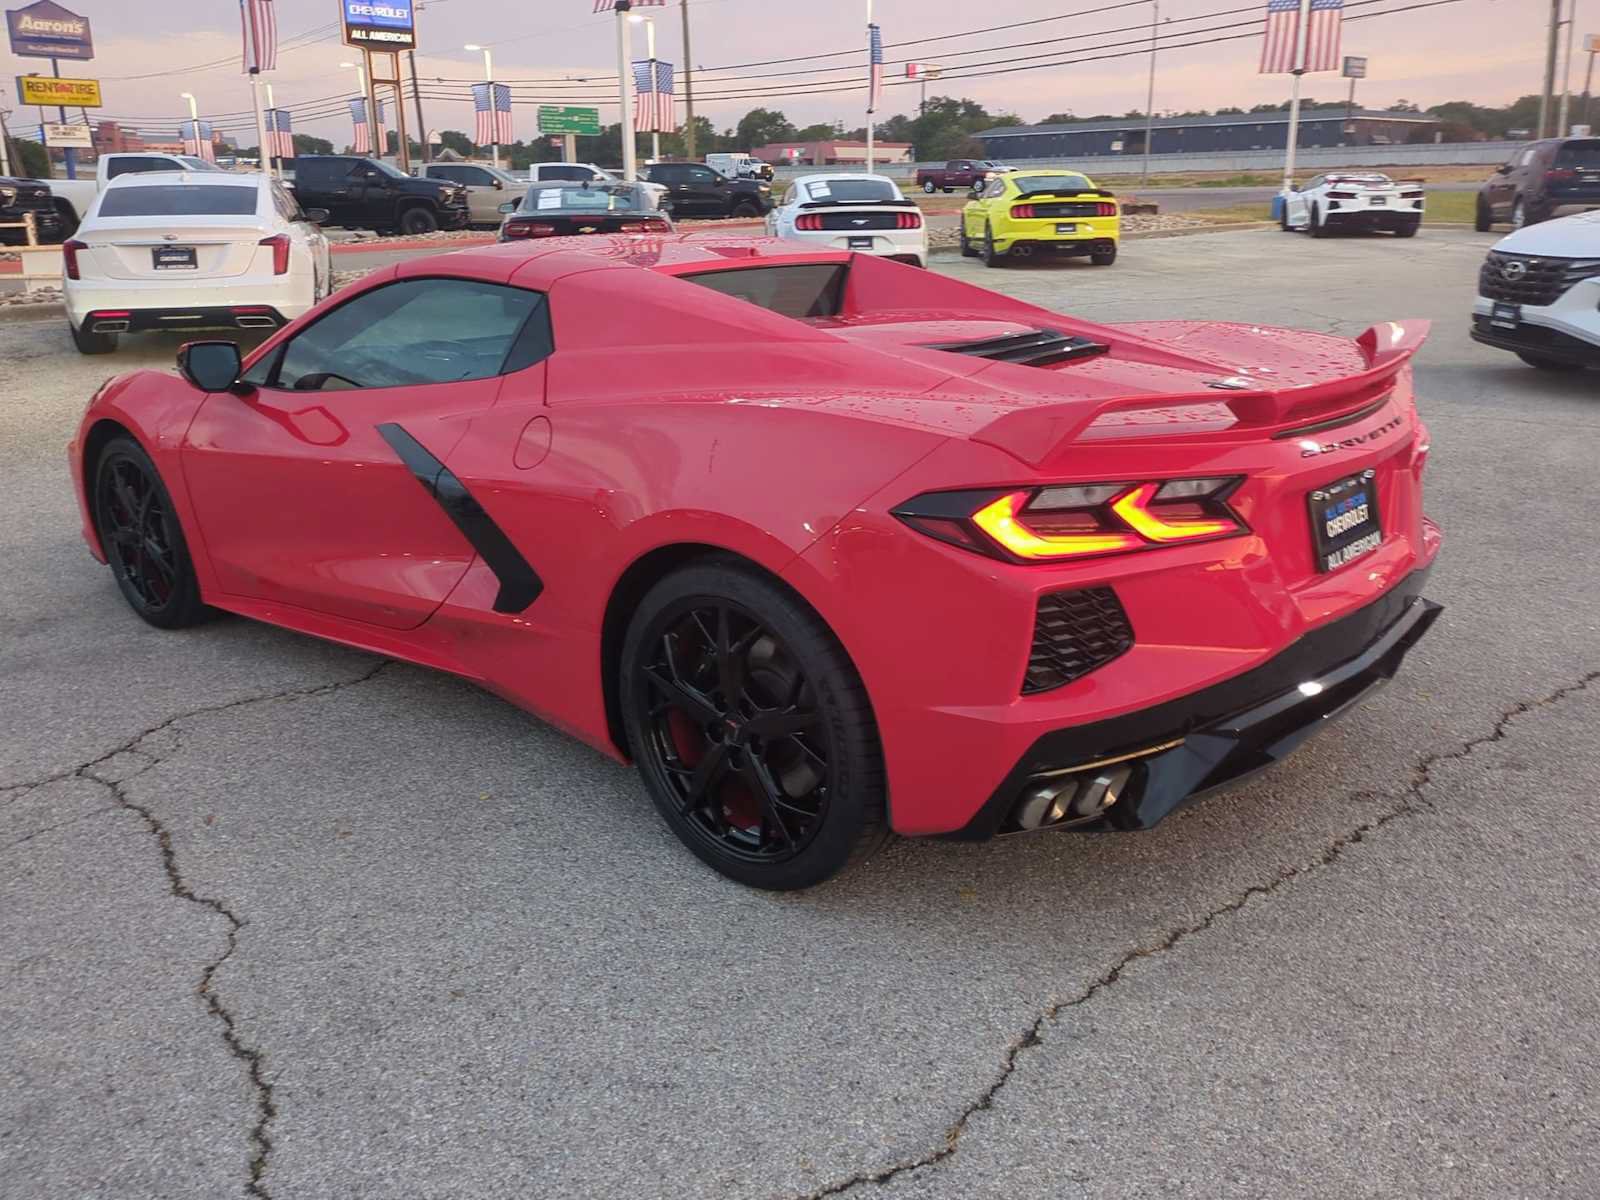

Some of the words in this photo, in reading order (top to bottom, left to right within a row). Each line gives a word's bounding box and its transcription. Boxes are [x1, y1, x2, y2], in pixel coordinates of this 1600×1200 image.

[350, 5, 408, 18] CHEVROLET
[18, 14, 84, 33] Aaron's
[351, 29, 368, 40] ALL
[369, 31, 413, 43] AMERICAN
[26, 81, 58, 93] RENT
[1301, 416, 1402, 458] CORVETTE
[1326, 504, 1368, 538] CHEVROLET
[1328, 551, 1344, 571] ALL
[1343, 531, 1382, 563] AMERICAN
